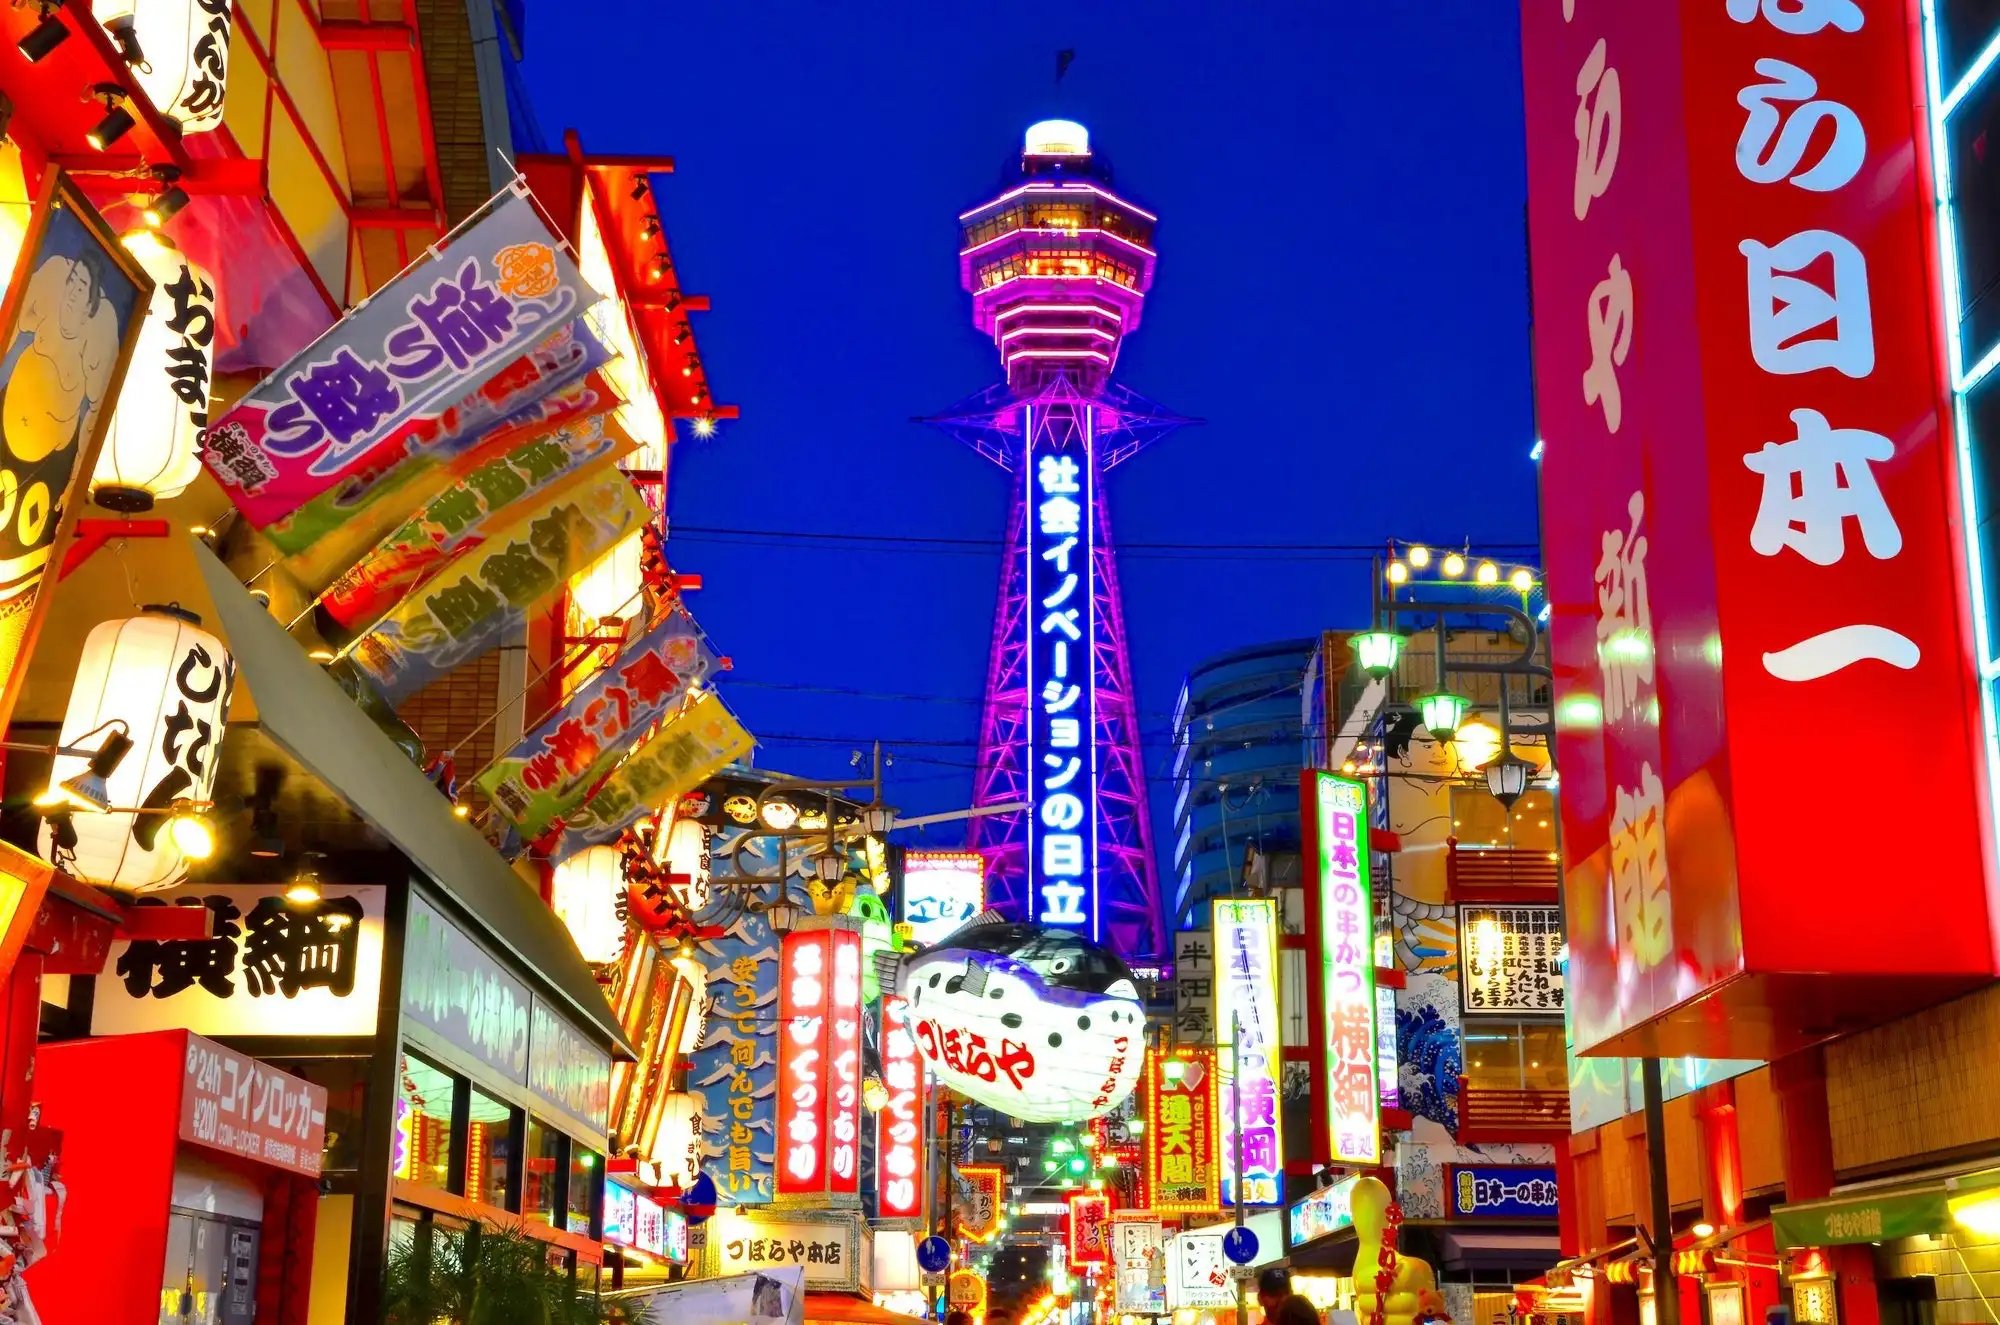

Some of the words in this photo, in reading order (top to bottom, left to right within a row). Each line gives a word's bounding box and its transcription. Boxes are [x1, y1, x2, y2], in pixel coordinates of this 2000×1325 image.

[1038, 454, 1087, 925] 社会イノベーションの日立
[1331, 812, 1363, 992] 日本一の串かつ
[1502, 957, 1518, 1007] 紅しょうが
[1517, 957, 1533, 1008] にんにく
[1533, 957, 1550, 1008] 玉ねぎ
[196, 1049, 222, 1096] 24h
[220, 1057, 326, 1140] コインロッカー
[916, 1018, 1035, 1091] づぼらや
[1330, 1002, 1373, 1123] 横綱
[1159, 1093, 1193, 1184] 通天閣
[1193, 1094, 1206, 1184] TSUTENKAKU
[1475, 1180, 1557, 1205] 日本一の串か
[726, 1237, 842, 1266] づぼらや本店
